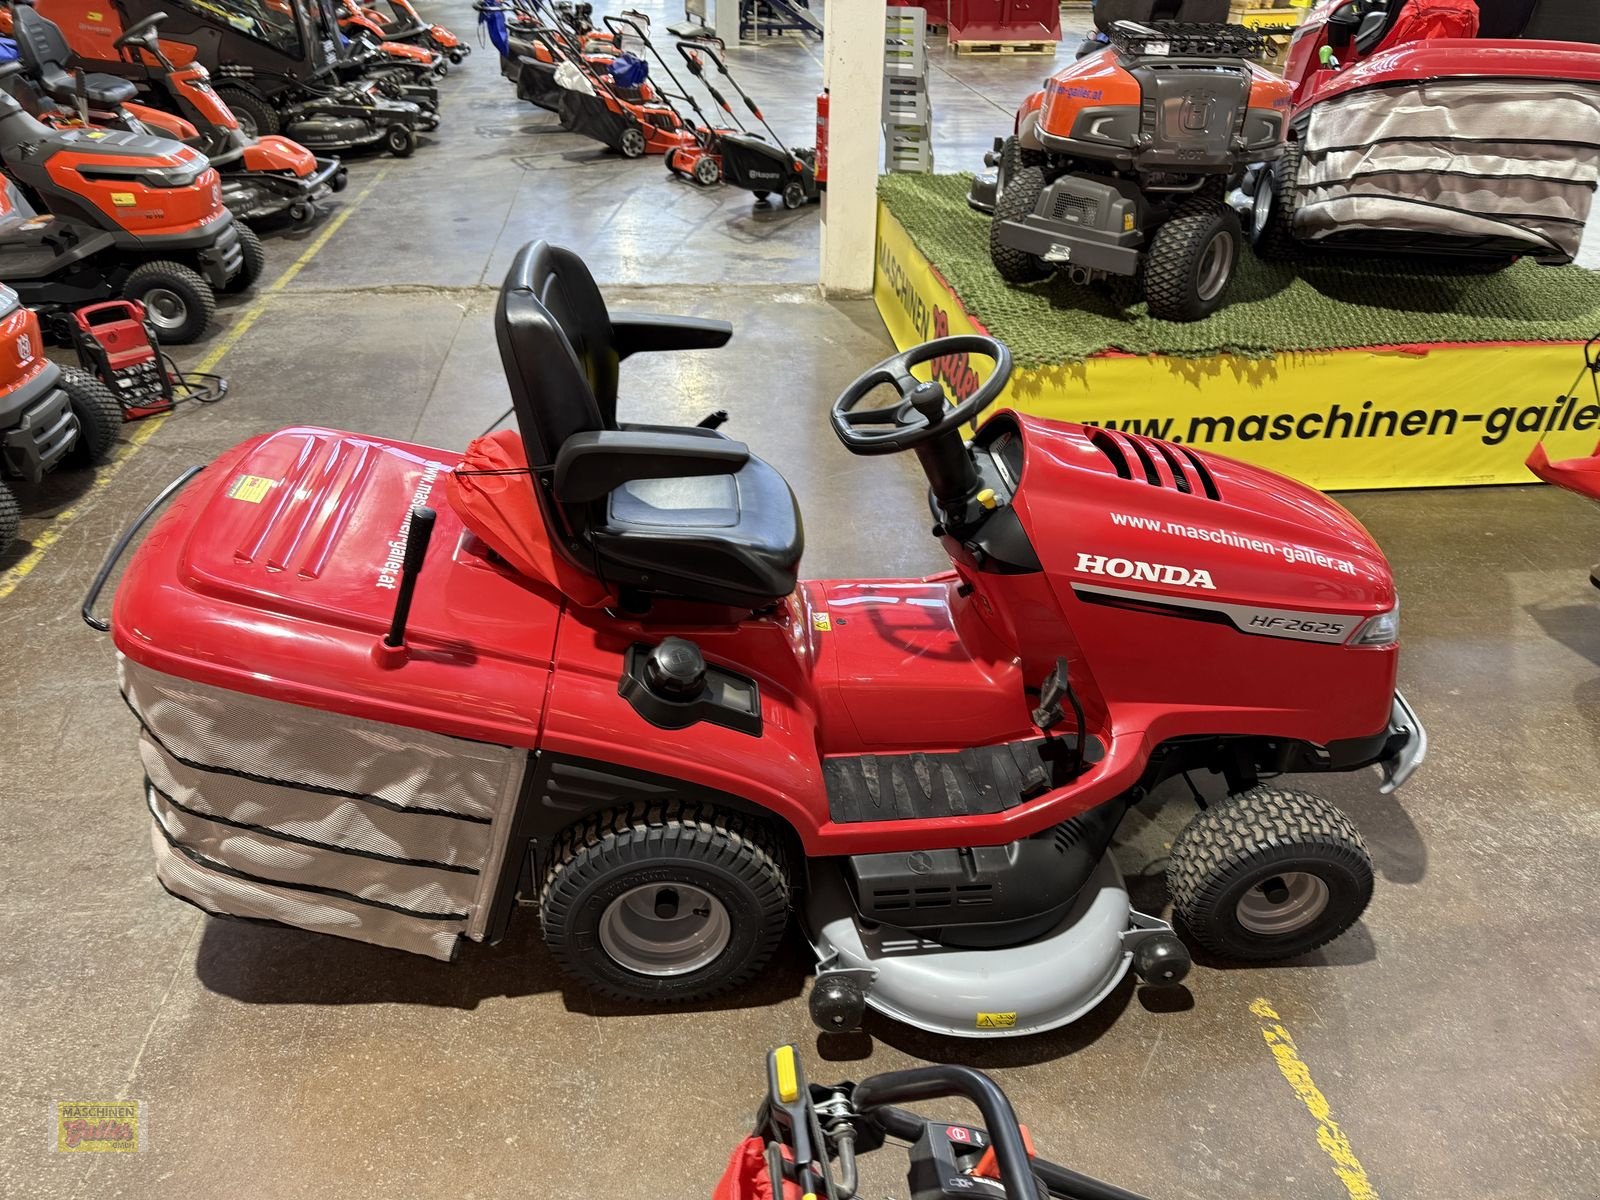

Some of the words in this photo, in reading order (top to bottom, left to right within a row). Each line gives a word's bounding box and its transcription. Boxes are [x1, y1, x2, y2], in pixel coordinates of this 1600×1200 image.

[879, 235, 931, 342] MASCHINEN
[1074, 552, 1217, 590] HONDA
[1110, 512, 1357, 576] www.maschinen-gailer.at
